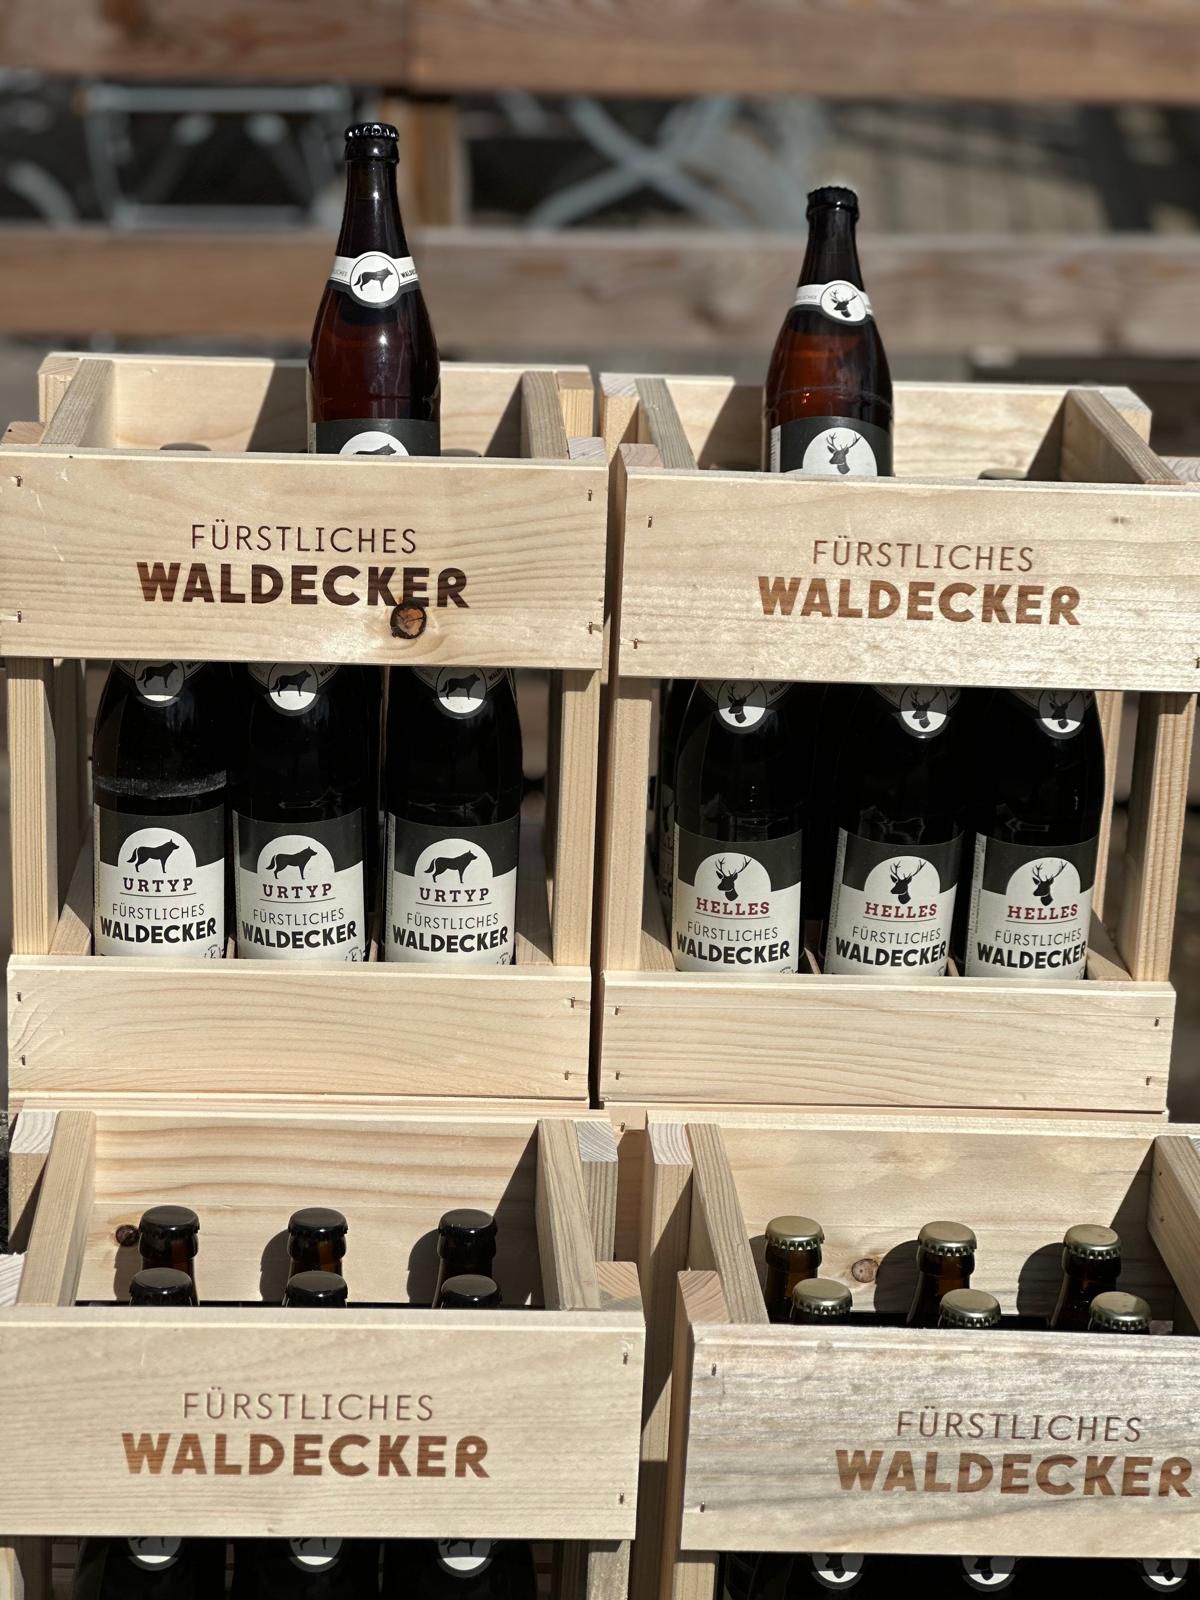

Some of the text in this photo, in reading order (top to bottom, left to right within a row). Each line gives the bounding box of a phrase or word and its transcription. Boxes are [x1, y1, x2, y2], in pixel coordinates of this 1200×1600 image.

[191, 519, 417, 554] FÜRSTLICHES
[812, 535, 1034, 572] FÜRSTLICHES
[136, 561, 471, 608] WALDECKER
[757, 575, 1082, 626] WALDECKER
[122, 877, 194, 893] URTYP
[262, 883, 332, 899] URTYP
[419, 887, 490, 903] URTYP
[112, 902, 205, 920] FÜRSTLICHES
[253, 907, 345, 926] FÜRSTLICHES
[406, 911, 500, 930] FÜRSTLICHES
[696, 897, 770, 916] HELLES
[864, 901, 938, 919] HELLES
[1007, 903, 1079, 921] HELLES
[100, 915, 217, 944] WALDECKER
[241, 920, 358, 949] WALDECKER
[392, 924, 509, 953] WALDECKER
[687, 920, 779, 942] FÜRSTLICHES
[852, 925, 941, 945] FÜRSTLICHES
[994, 927, 1082, 947] FÜRSTLICHES
[676, 931, 791, 965] WALDECKER
[835, 936, 947, 967] WALDECKER
[976, 940, 1087, 969] WALDECKER
[183, 1386, 434, 1422] FÜRSTLICHES
[896, 1405, 1143, 1443] FÜRSTLICHES
[121, 1432, 490, 1479] WALDECKER
[835, 1450, 1194, 1498] WALDECKER
